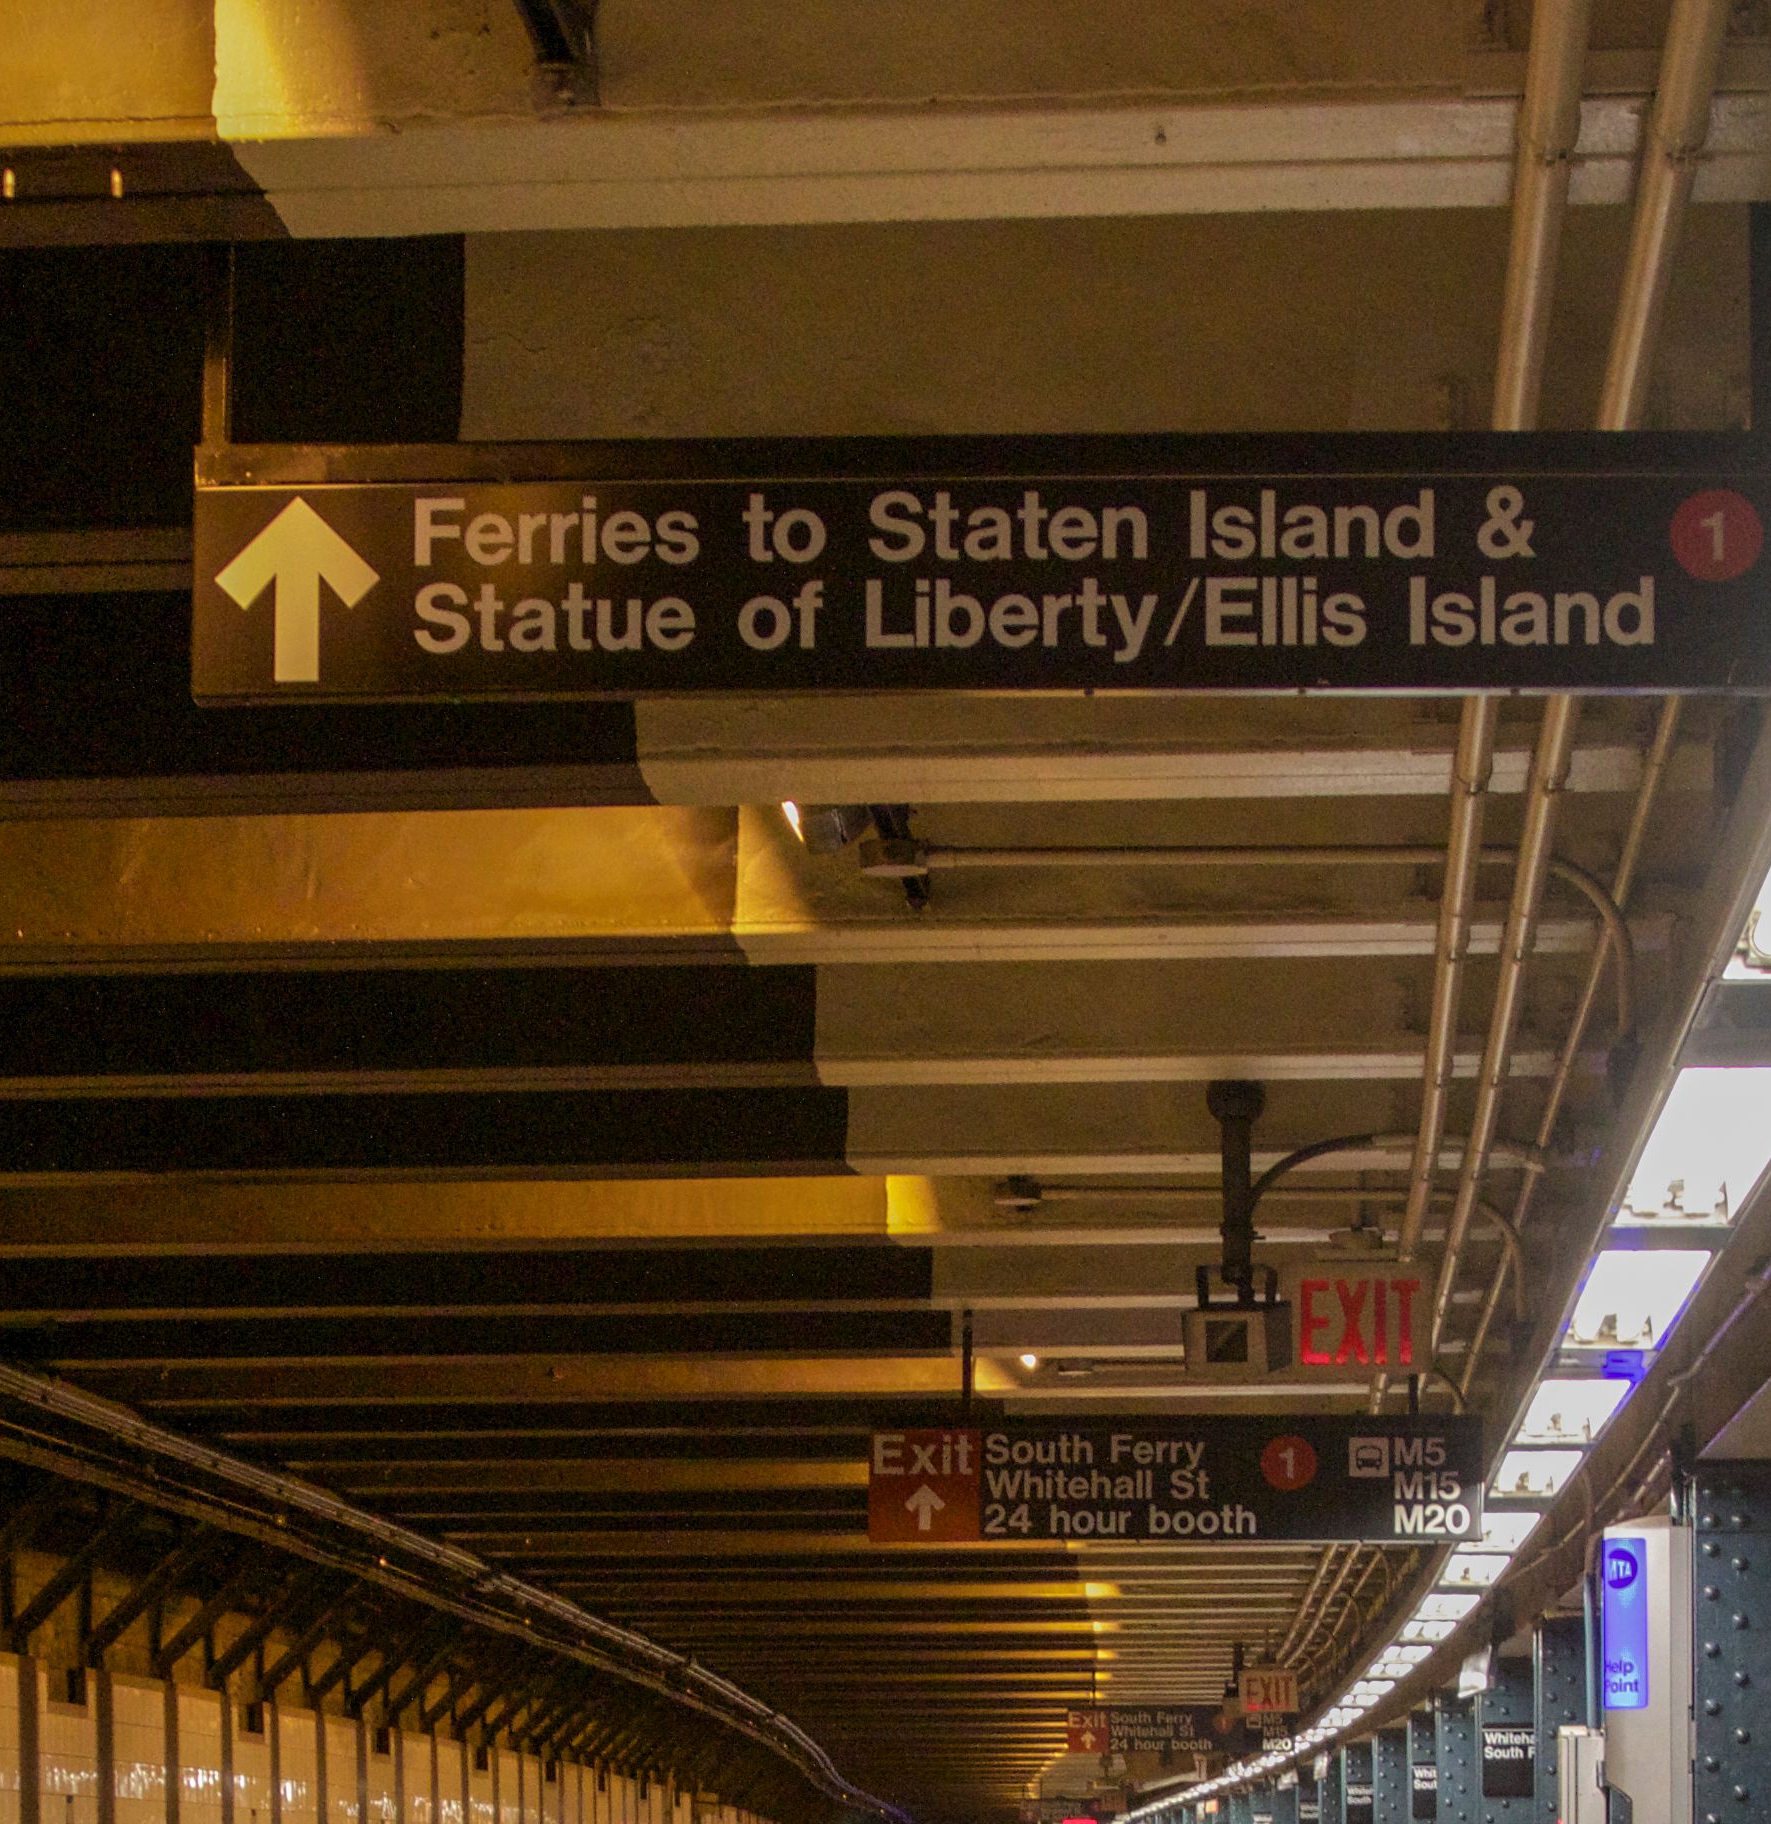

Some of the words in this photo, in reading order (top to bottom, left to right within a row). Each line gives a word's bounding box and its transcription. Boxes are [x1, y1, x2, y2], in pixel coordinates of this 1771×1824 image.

[414, 496, 700, 566] Ferries
[742, 494, 826, 564] to
[869, 491, 1147, 563] Staten
[1190, 489, 1435, 559] Island
[1478, 485, 1536, 559] &
[1701, 510, 1725, 561] 1
[414, 582, 696, 653] Statue
[738, 579, 824, 650] of
[865, 577, 1366, 663] Liberty/Ellis
[1410, 576, 1655, 646] Island
[1300, 1279, 1420, 1365] EXIT
[873, 1434, 973, 1475] Exit
[985, 1433, 1093, 1464] South
[1111, 1433, 1205, 1469] Ferry
[1279, 1447, 1295, 1479] 1
[1394, 1437, 1446, 1466] M5
[986, 1469, 1153, 1500] Whitehall
[1170, 1469, 1210, 1500] St
[1394, 1471, 1462, 1500] M15
[984, 1504, 1032, 1534] 24
[1050, 1504, 1131, 1534] hour
[1149, 1503, 1257, 1534] booth
[1394, 1504, 1471, 1534] M20
[1604, 1659, 1634, 1677] Help
[1245, 1676, 1293, 1710] EXIT
[1604, 1678, 1639, 1693] Point
[1068, 1713, 1107, 1728] Exit
[1110, 1711, 1152, 1724] South
[1157, 1711, 1193, 1727] Ferry
[1110, 1725, 1174, 1738] Whitehall
[1180, 1725, 1195, 1738] St
[1110, 1739, 1128, 1750] 24
[1134, 1739, 1168, 1750] hour
[1171, 1739, 1213, 1750] booth
[1262, 1738, 1292, 1750] M20
[1484, 1746, 1524, 1759] South
